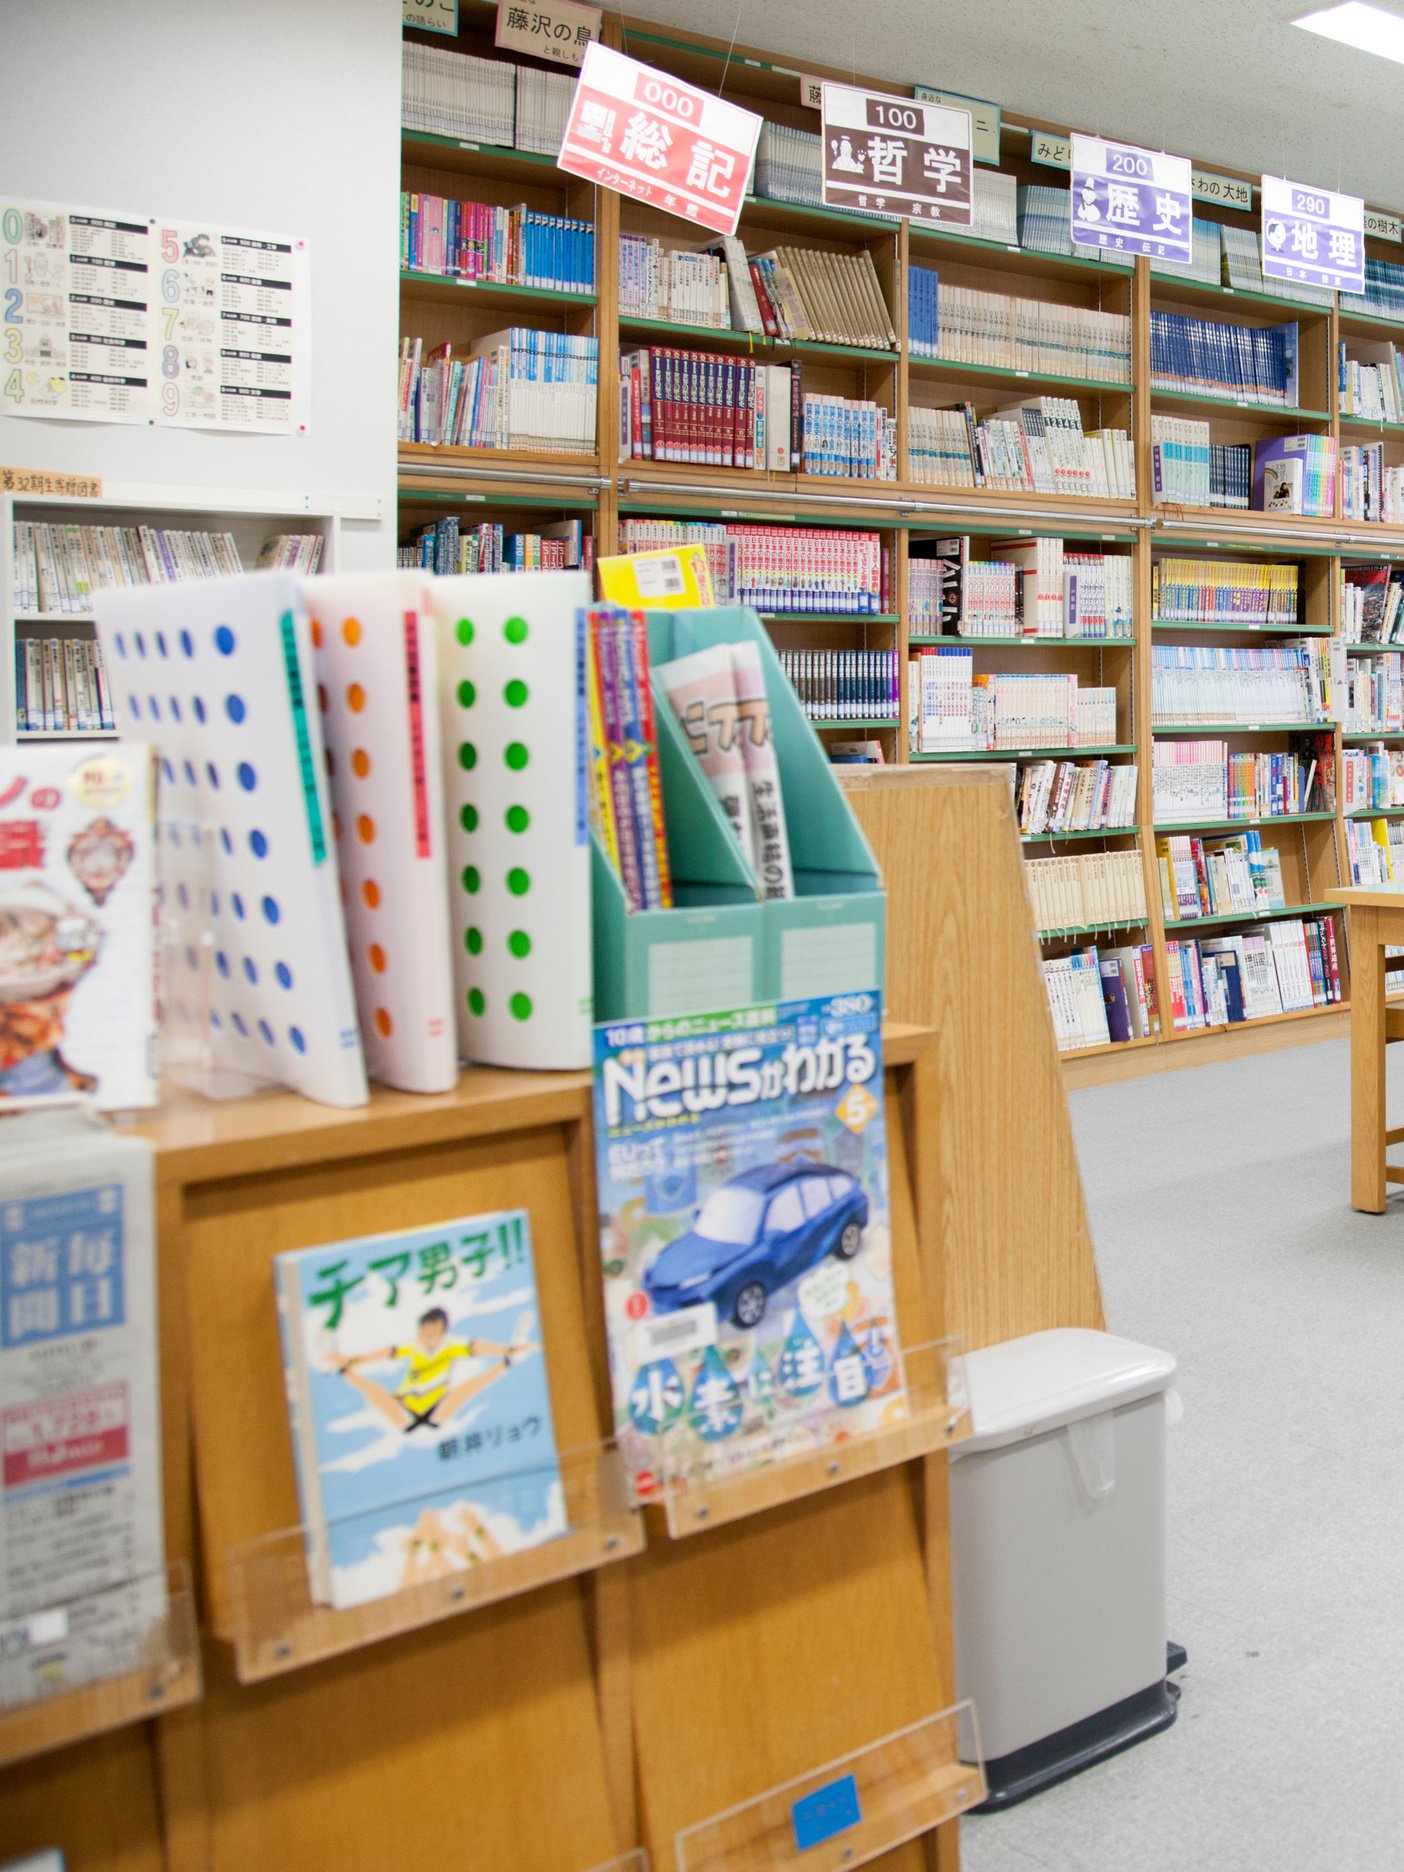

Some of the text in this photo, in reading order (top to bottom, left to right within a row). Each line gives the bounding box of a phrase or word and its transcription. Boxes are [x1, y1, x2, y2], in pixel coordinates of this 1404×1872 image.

[402, 13, 447, 28] の語らい
[643, 82, 694, 118] 000
[875, 105, 917, 129] 100
[620, 112, 736, 198] 総記
[868, 136, 962, 193] 哲学
[1112, 154, 1148, 176] 200
[597, 167, 653, 197] インターネット
[858, 194, 941, 218] 哲学 宗教
[1106, 183, 1184, 235] 歴史
[1296, 194, 1325, 215] 290
[3, 208, 23, 245] 0
[1098, 234, 1124, 249] 歴史
[1291, 221, 1357, 267] 地理
[161, 229, 180, 264] 5
[4, 249, 18, 284] 1
[161, 269, 180, 303] 6
[5, 288, 23, 324] 2
[161, 308, 180, 341] 7
[4, 328, 23, 364] 3
[162, 345, 180, 379] 8
[4, 369, 24, 404] 4
[161, 382, 180, 417] 9
[602, 1035, 876, 1126] Newsがわかる
[308, 1218, 528, 1329] チア男子!!
